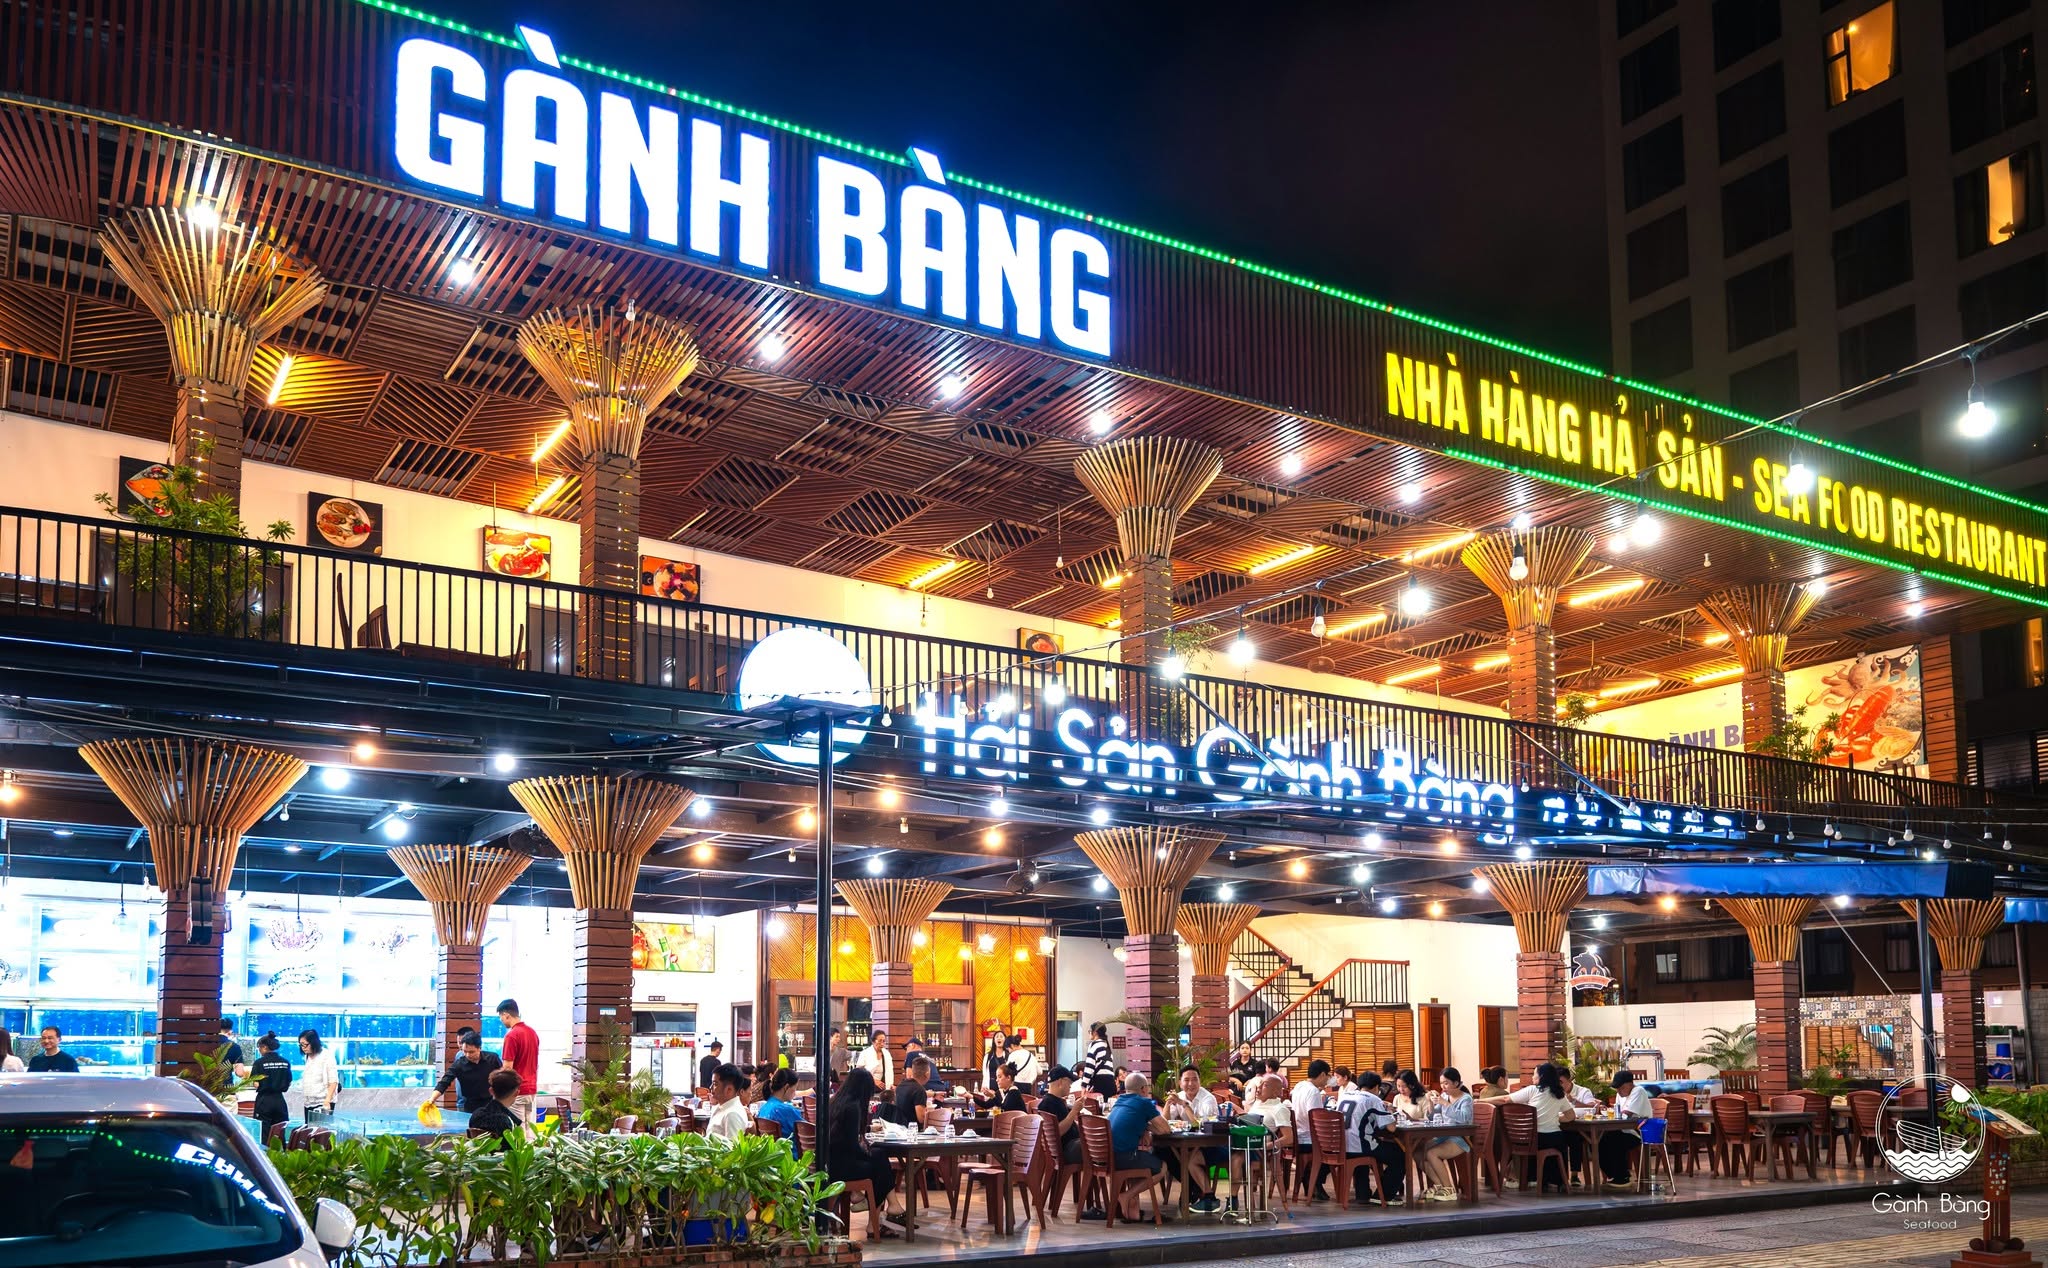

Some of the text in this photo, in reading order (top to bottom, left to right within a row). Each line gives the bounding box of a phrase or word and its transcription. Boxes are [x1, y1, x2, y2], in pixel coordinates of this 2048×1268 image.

[394, 24, 1111, 357] GÀNH BÀNG
[1386, 352, 1469, 435] NHÀ
[1480, 370, 1581, 464] HÀNG
[1658, 413, 1724, 501] SẢN
[1753, 457, 1810, 525] SEA
[1817, 475, 1885, 544] FOOD
[1891, 497, 2047, 588] RESTAURANT
[1641, 1017, 1655, 1025] WC
